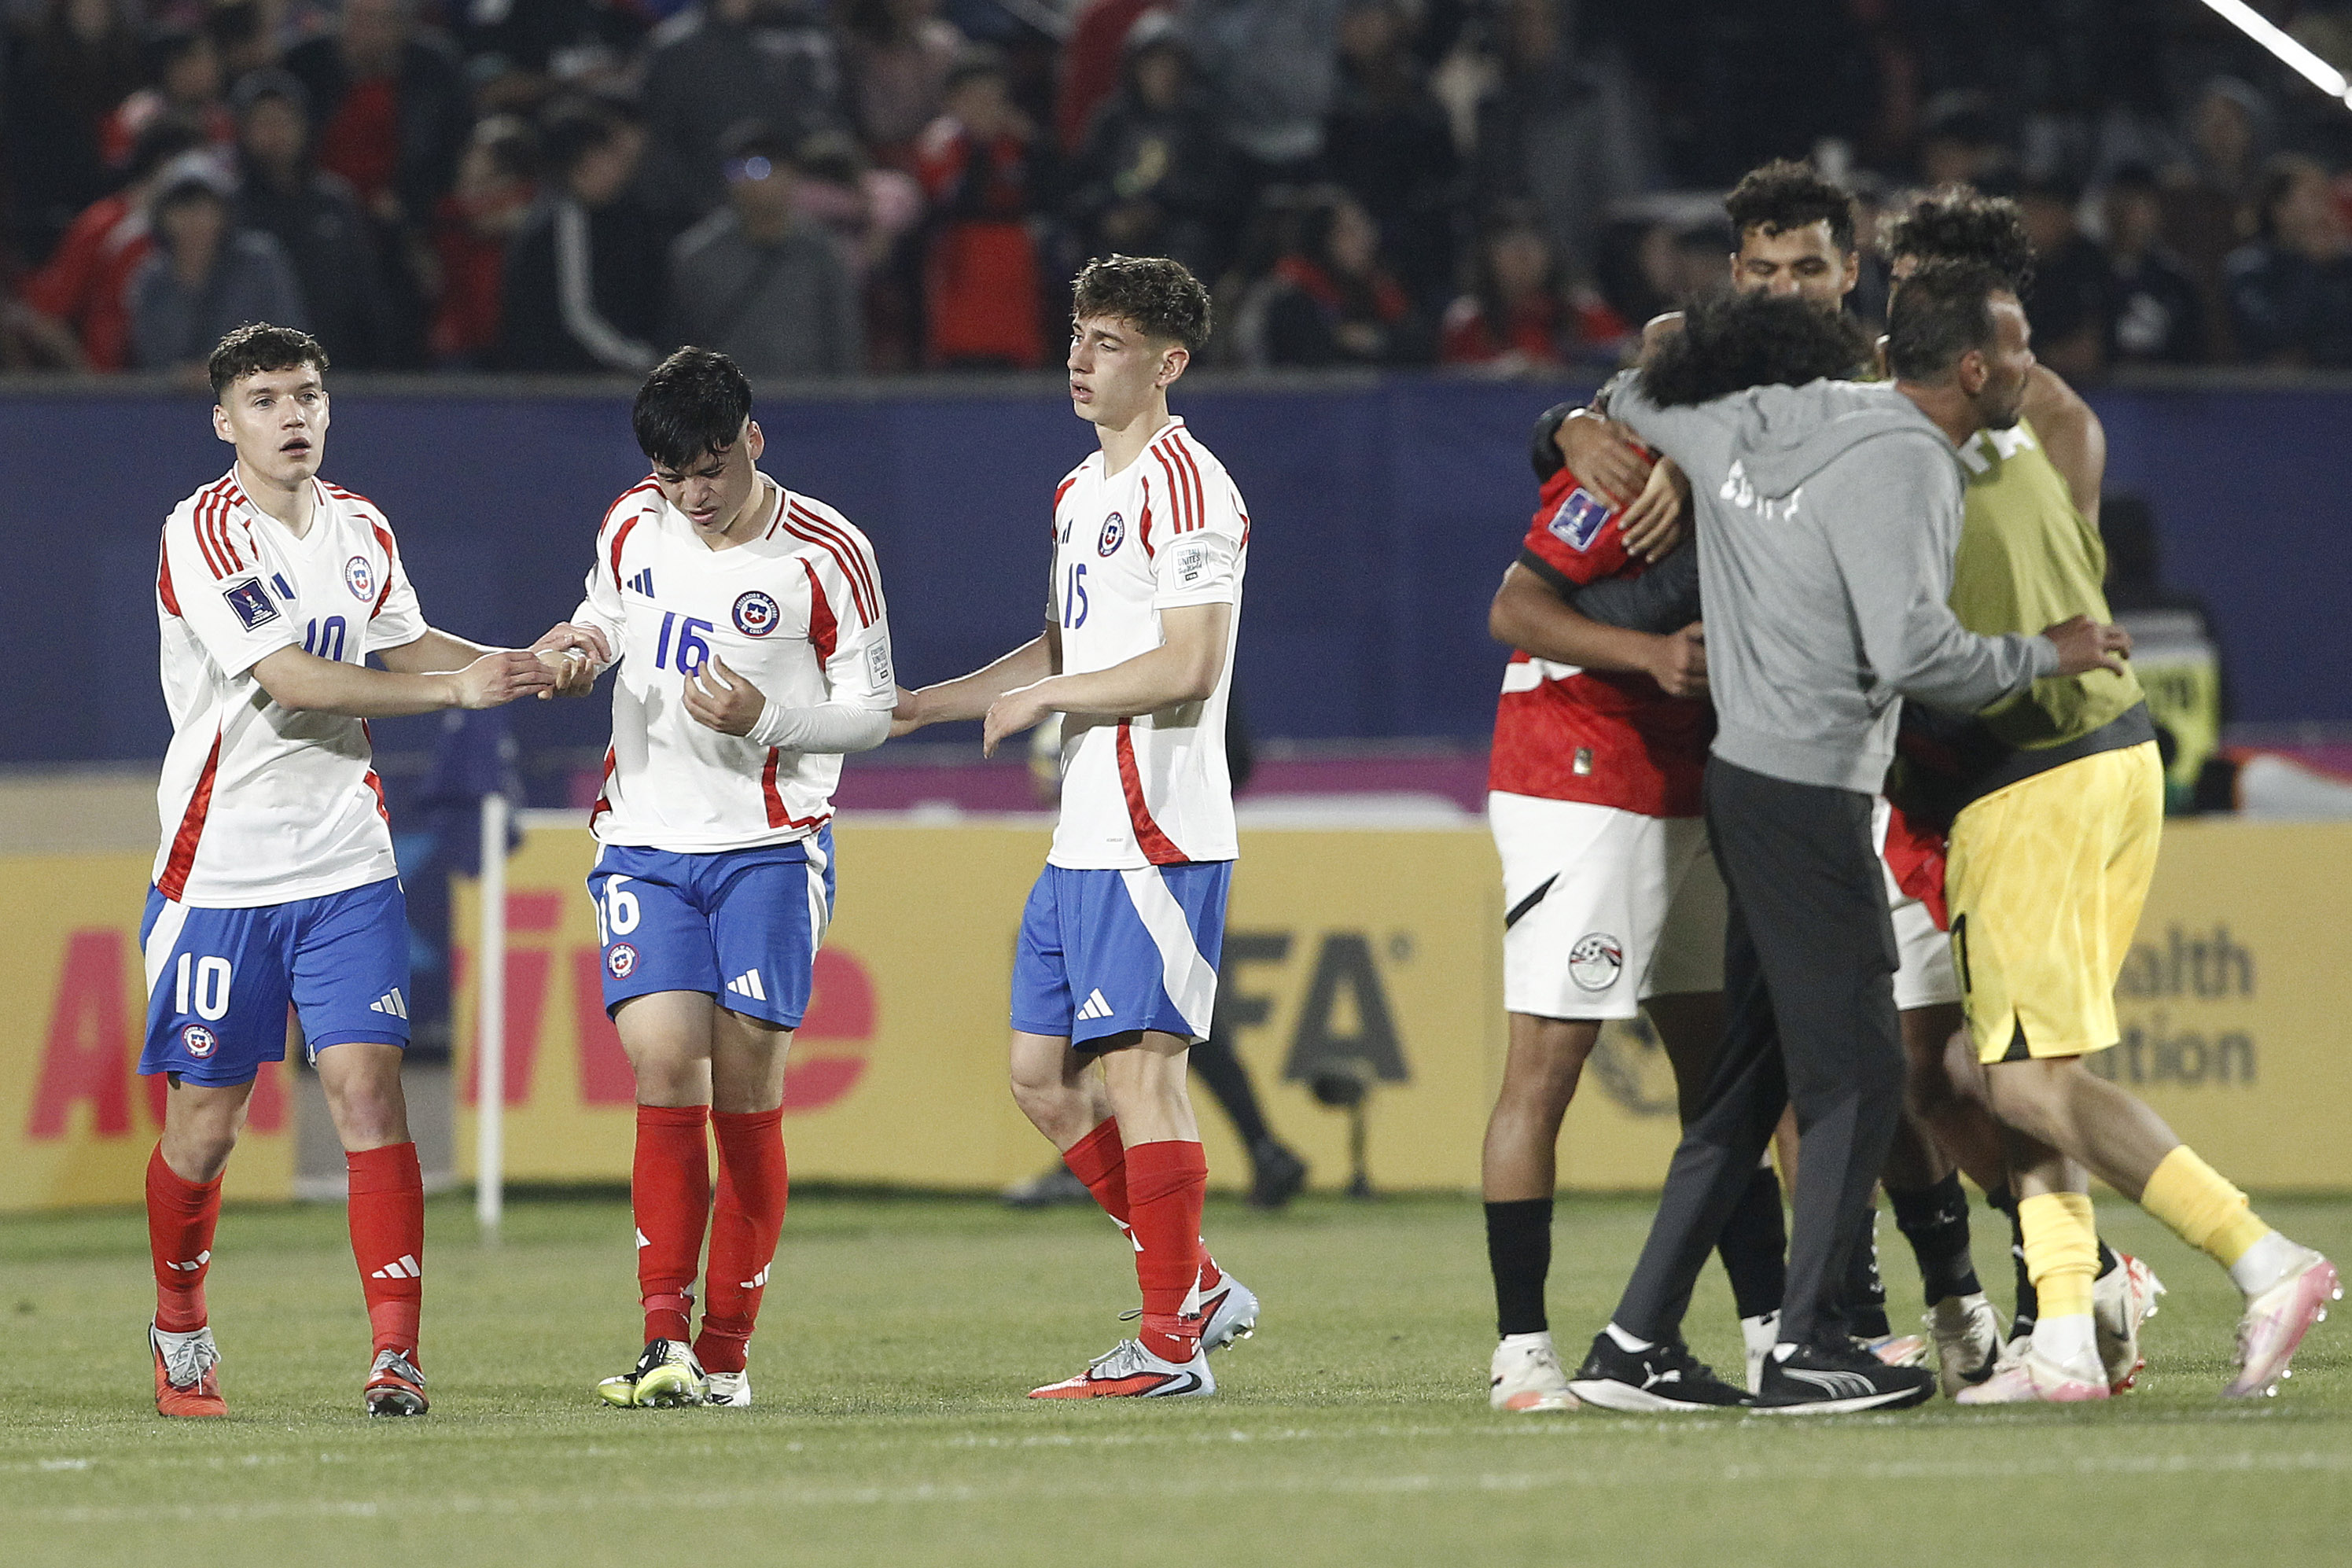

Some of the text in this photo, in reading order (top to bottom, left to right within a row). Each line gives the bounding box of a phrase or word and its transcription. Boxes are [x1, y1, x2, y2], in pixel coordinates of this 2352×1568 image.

[1064, 563, 1088, 629] 15
[304, 616, 346, 661] 10
[655, 611, 713, 677] 16
[600, 874, 641, 948] 16
[175, 951, 232, 1021] 10
